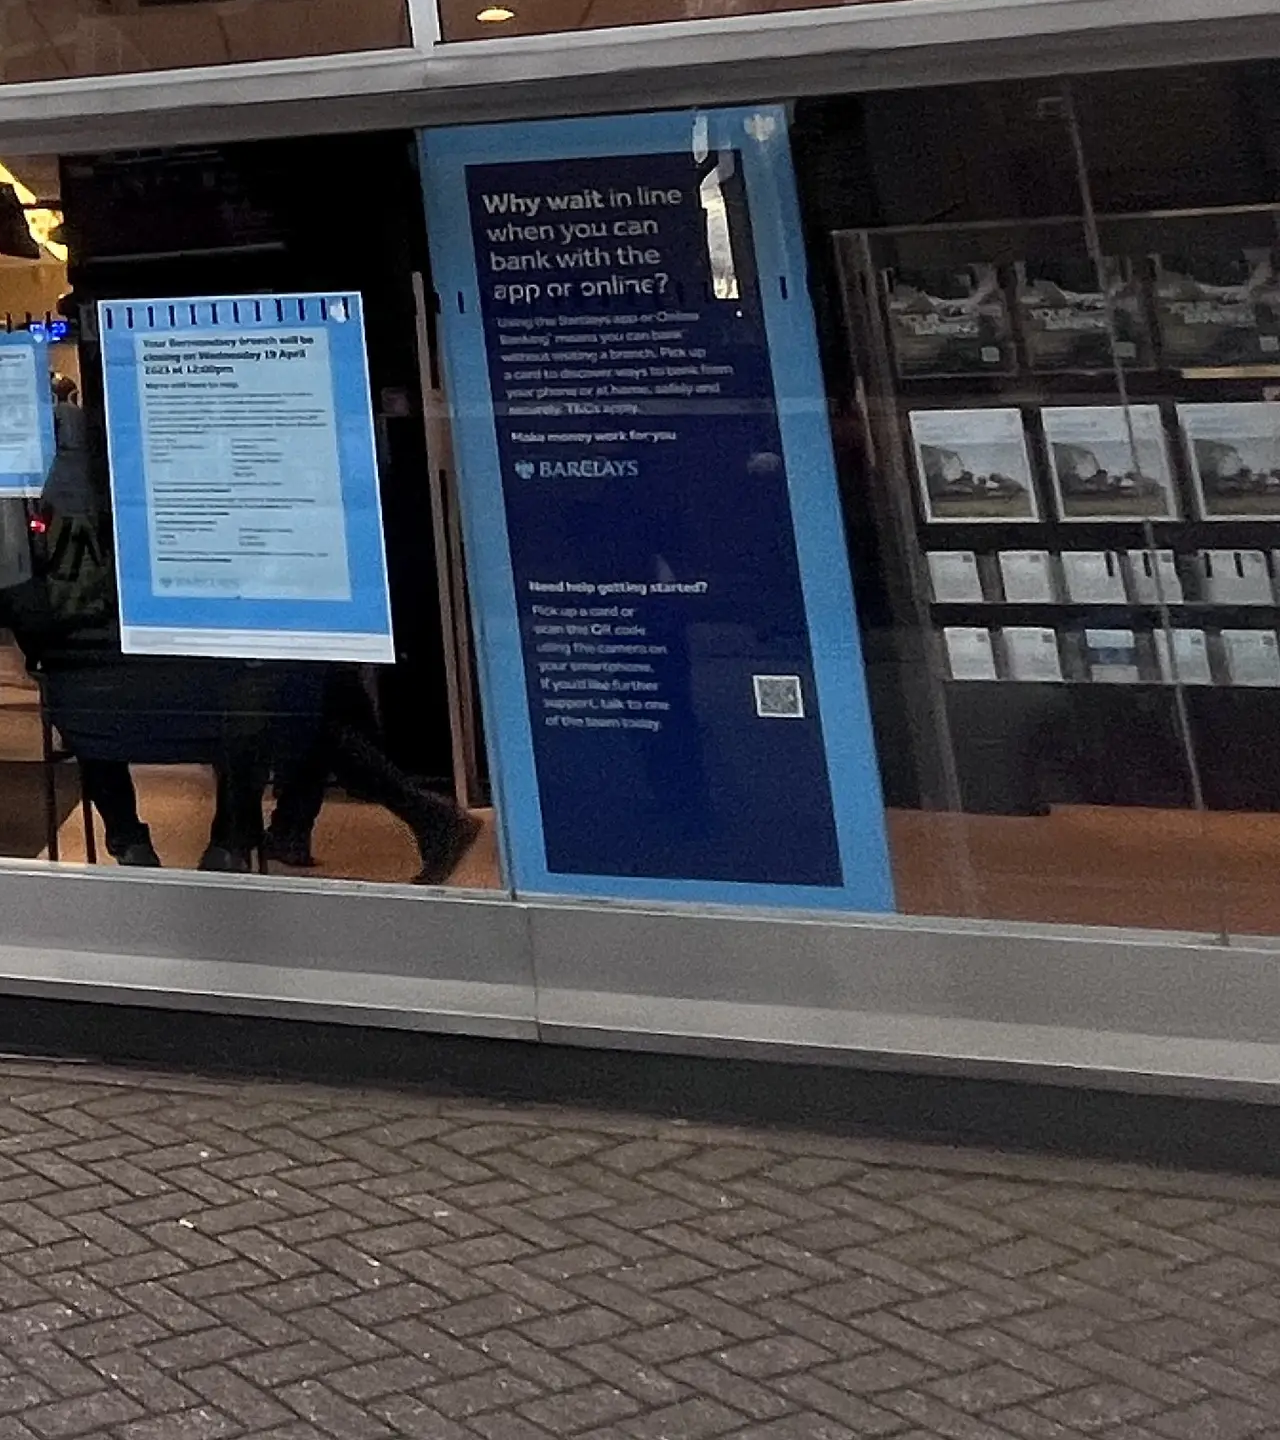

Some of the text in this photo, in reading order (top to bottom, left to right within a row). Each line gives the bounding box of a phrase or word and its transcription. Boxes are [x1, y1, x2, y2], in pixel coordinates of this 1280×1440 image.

[481, 186, 682, 217] Why wait in line
[487, 219, 659, 245] when you can
[490, 245, 661, 272] bank with the
[493, 272, 669, 305] app or online?
[278, 348, 307, 361] April
[546, 432, 593, 445] money
[594, 430, 628, 442] work
[540, 460, 639, 478] BARCLAYS
[528, 580, 709, 596] Need help getting started?
